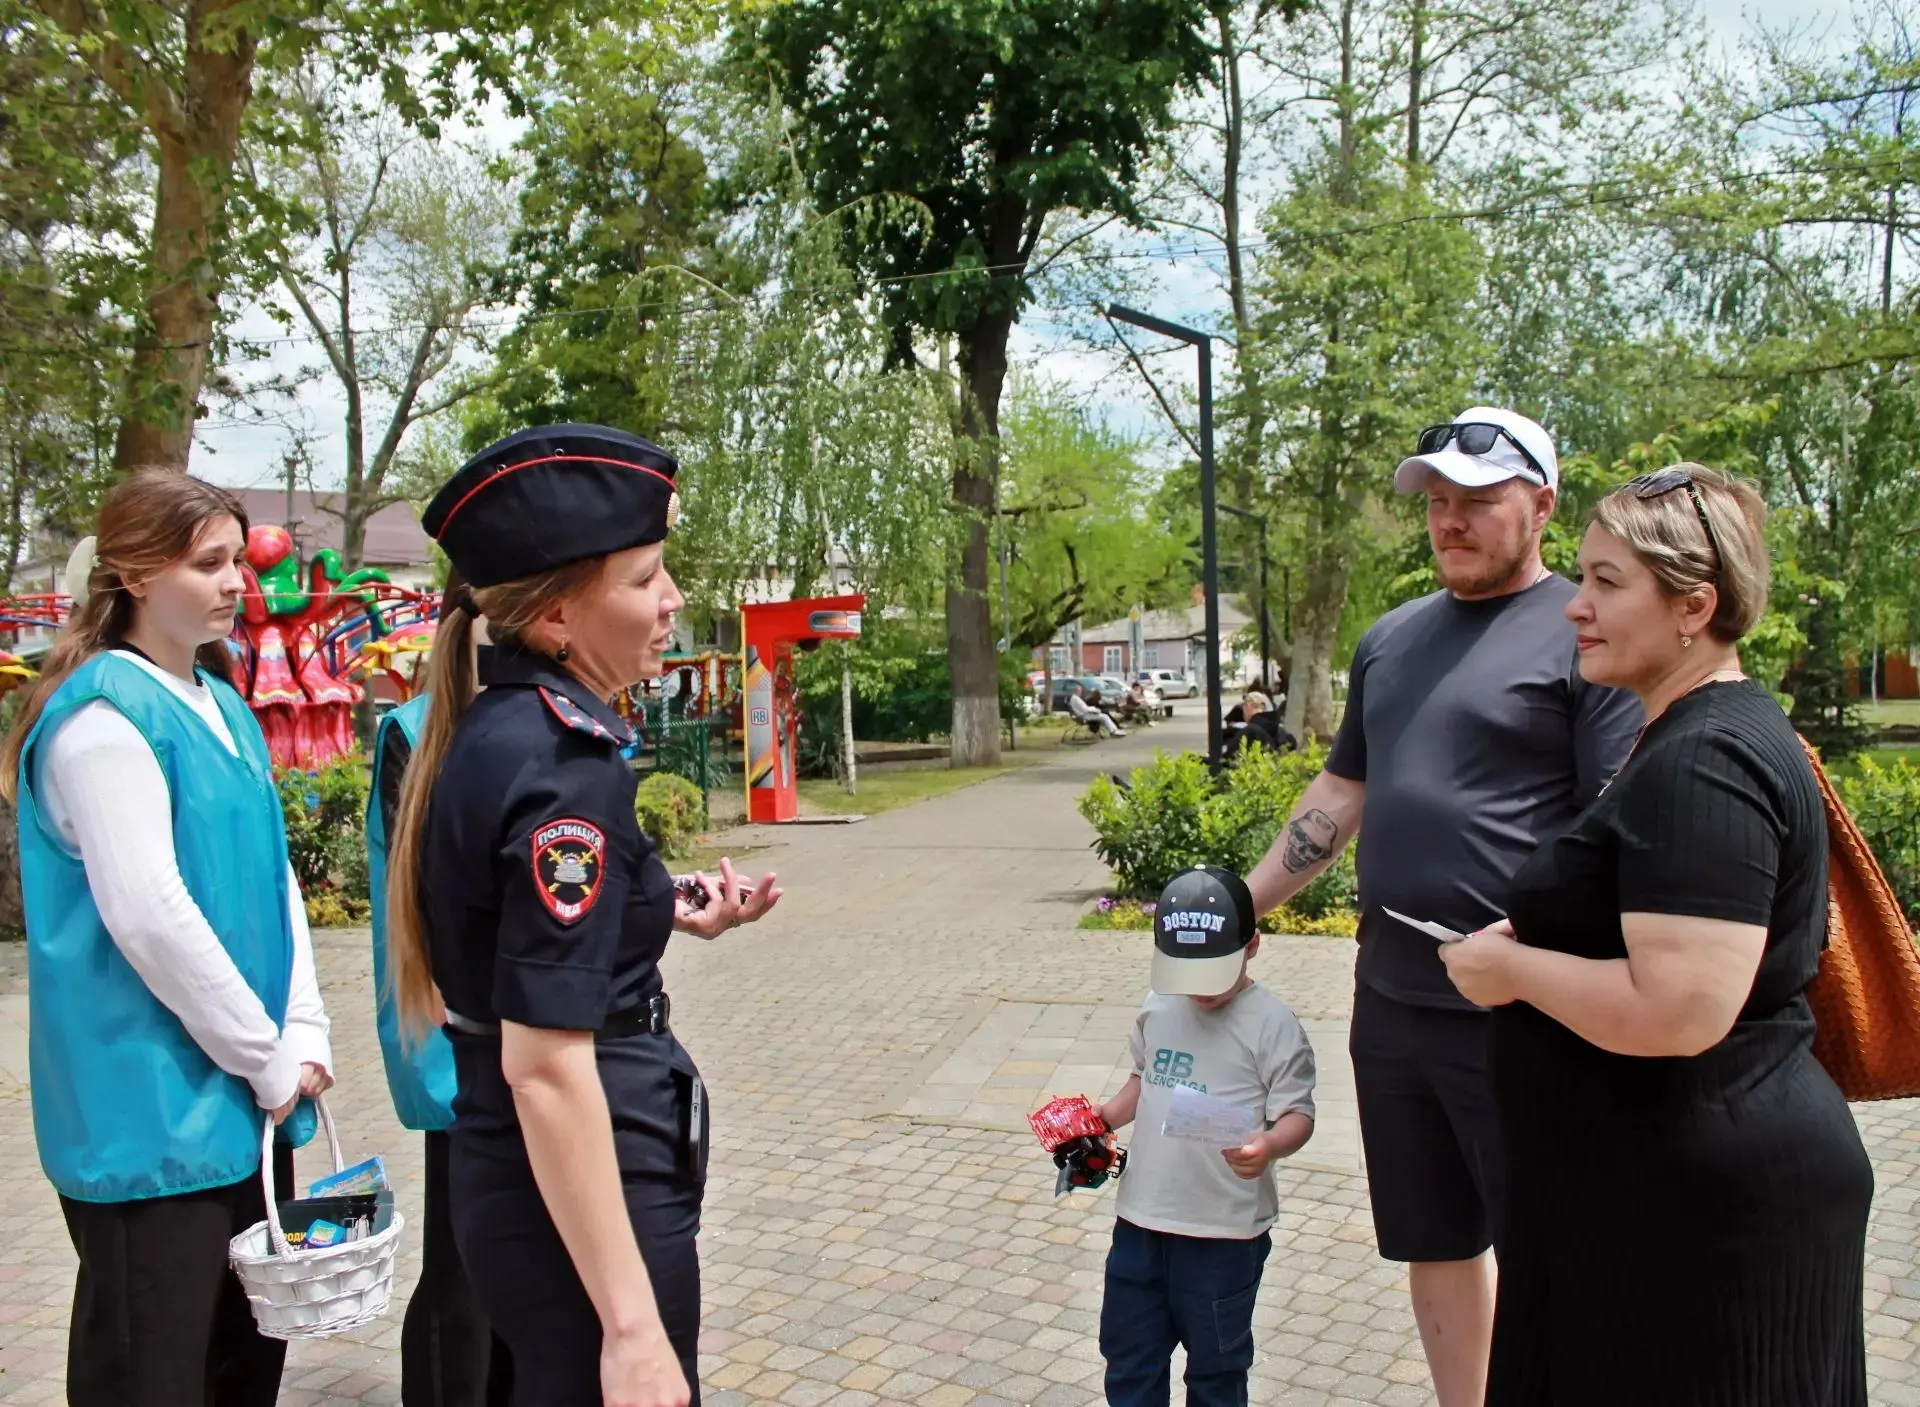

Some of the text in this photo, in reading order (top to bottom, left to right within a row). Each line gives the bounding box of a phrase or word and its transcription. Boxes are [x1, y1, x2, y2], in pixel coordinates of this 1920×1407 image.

[753, 710, 766, 723] RB
[538, 825, 602, 851] ПОЛИЦИЯ
[555, 900, 582, 918] МВД
[1162, 911, 1226, 932] BOSTON
